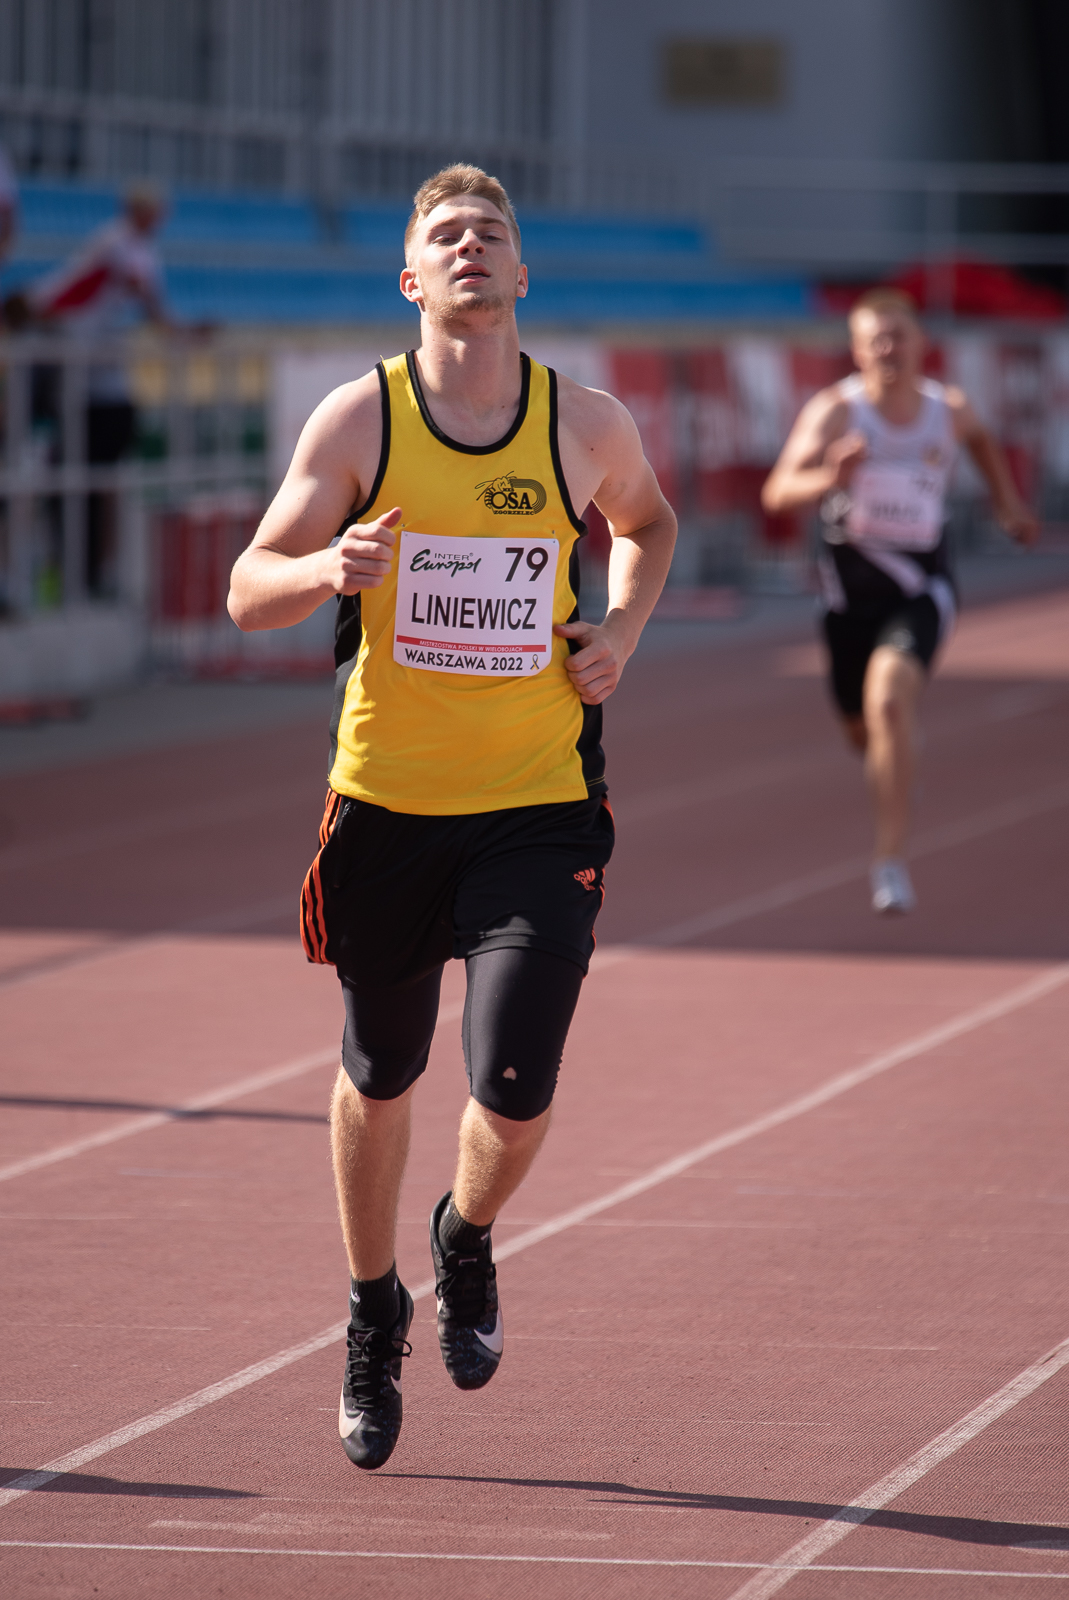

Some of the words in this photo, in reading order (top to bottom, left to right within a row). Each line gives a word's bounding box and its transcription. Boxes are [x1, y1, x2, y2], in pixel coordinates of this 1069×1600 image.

[491, 492, 533, 509] OSA
[410, 549, 481, 577] Europol
[505, 547, 549, 582] 79
[411, 592, 537, 631] LINIEWICZ
[419, 640, 457, 650] MISTRZOSTWA
[405, 648, 487, 671] WARSZAWA
[490, 657, 523, 671] 2022
